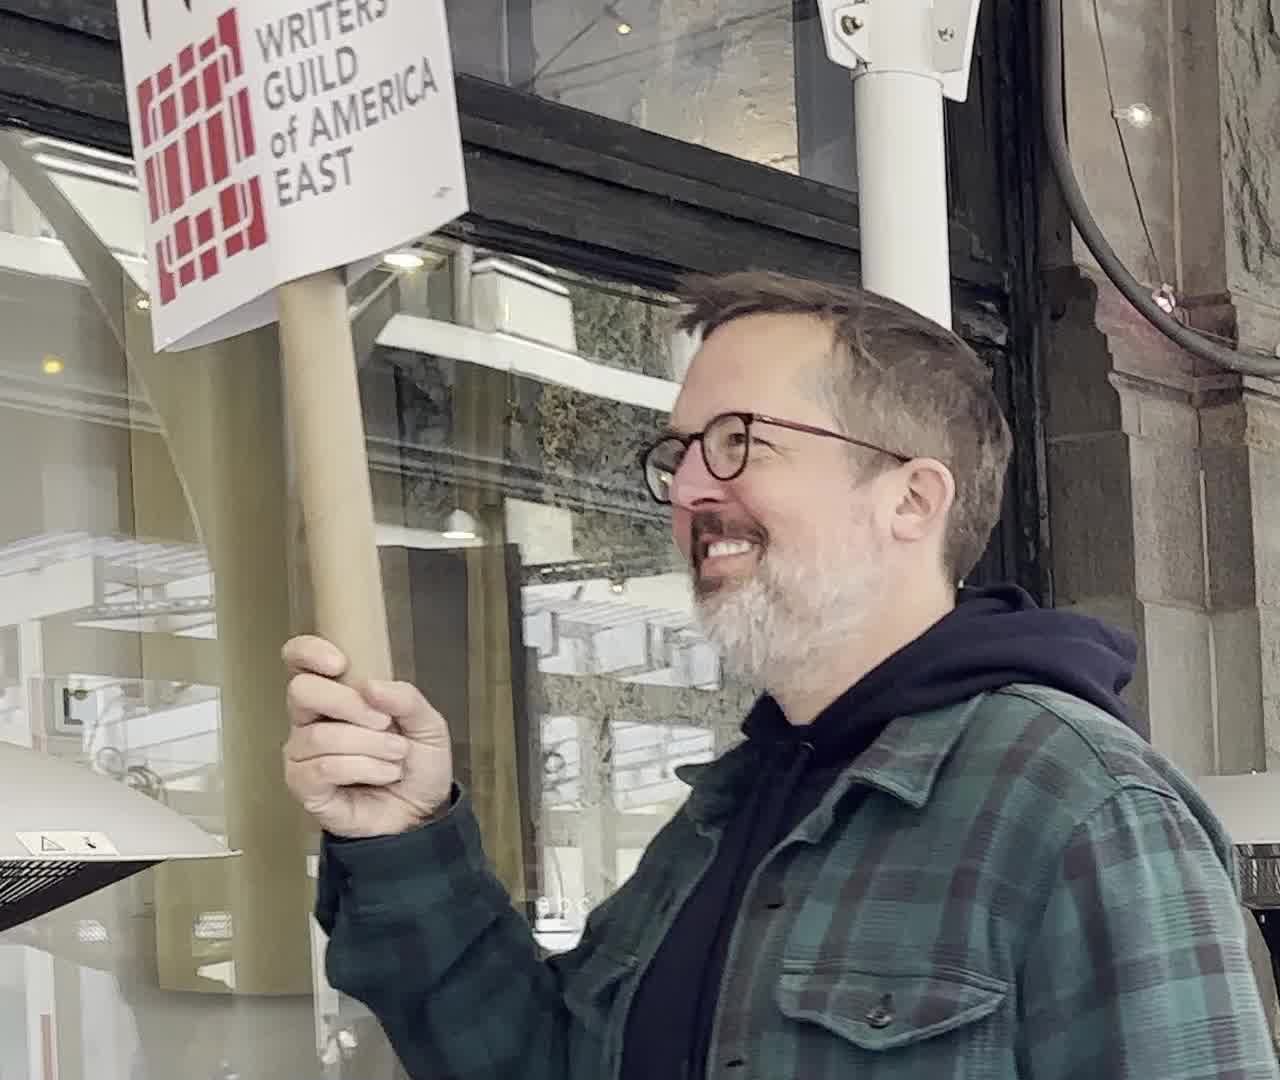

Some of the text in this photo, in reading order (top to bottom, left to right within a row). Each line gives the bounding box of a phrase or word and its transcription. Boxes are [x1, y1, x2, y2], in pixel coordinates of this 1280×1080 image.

[255, 0, 388, 63] WRITERS
[263, 45, 359, 111] GUILD
[269, 55, 439, 160] of AMERICA
[274, 147, 355, 207] EAST
